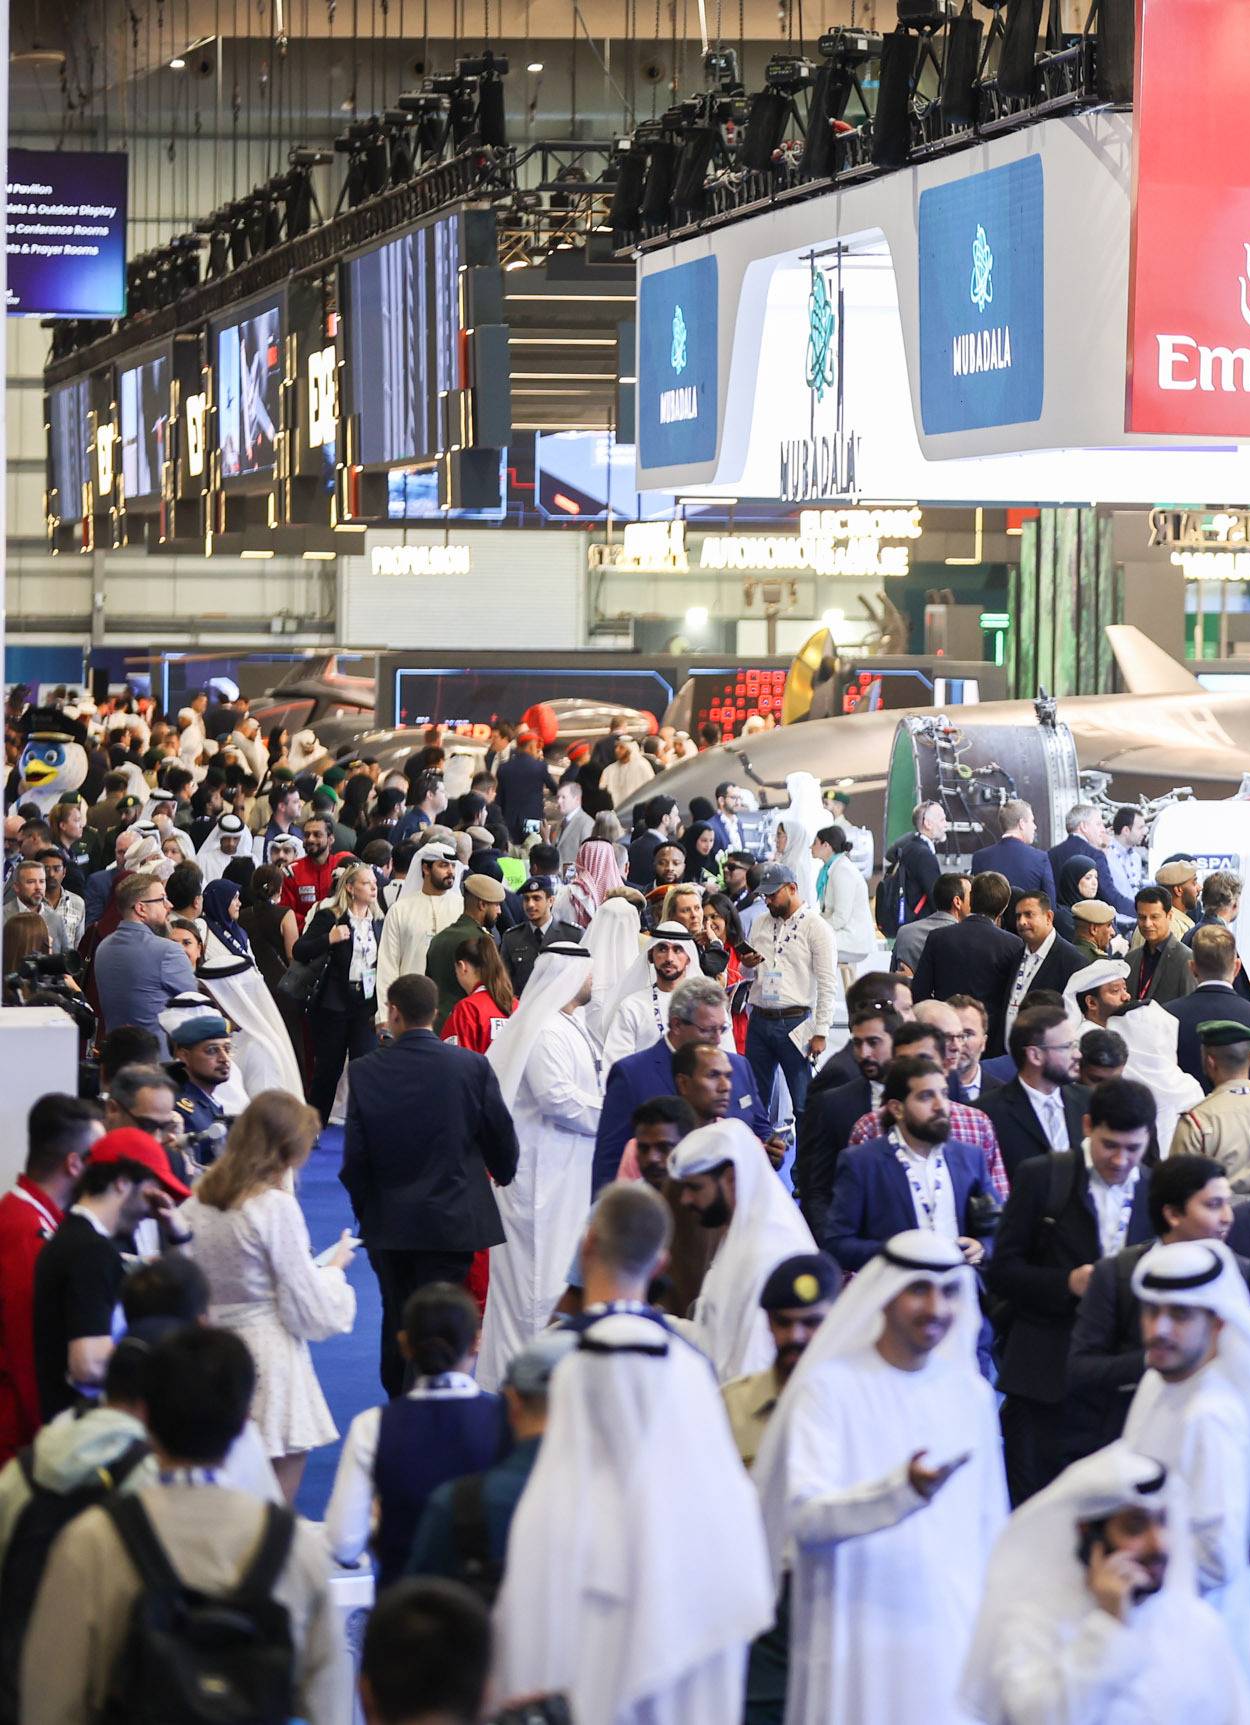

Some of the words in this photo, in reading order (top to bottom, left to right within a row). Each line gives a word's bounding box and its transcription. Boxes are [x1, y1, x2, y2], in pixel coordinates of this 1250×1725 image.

[13, 183, 53, 195] Pavilion
[28, 204, 37, 215] &
[38, 203, 79, 216] Outdoor
[79, 204, 117, 219] Display
[16, 223, 74, 235] Conference
[74, 225, 110, 237] Rooms
[21, 244, 31, 255] &
[31, 243, 64, 257] Prayer
[64, 245, 100, 256] Rooms
[953, 326, 1012, 377] MUBADALA
[659, 386, 698, 424] MUBADALA
